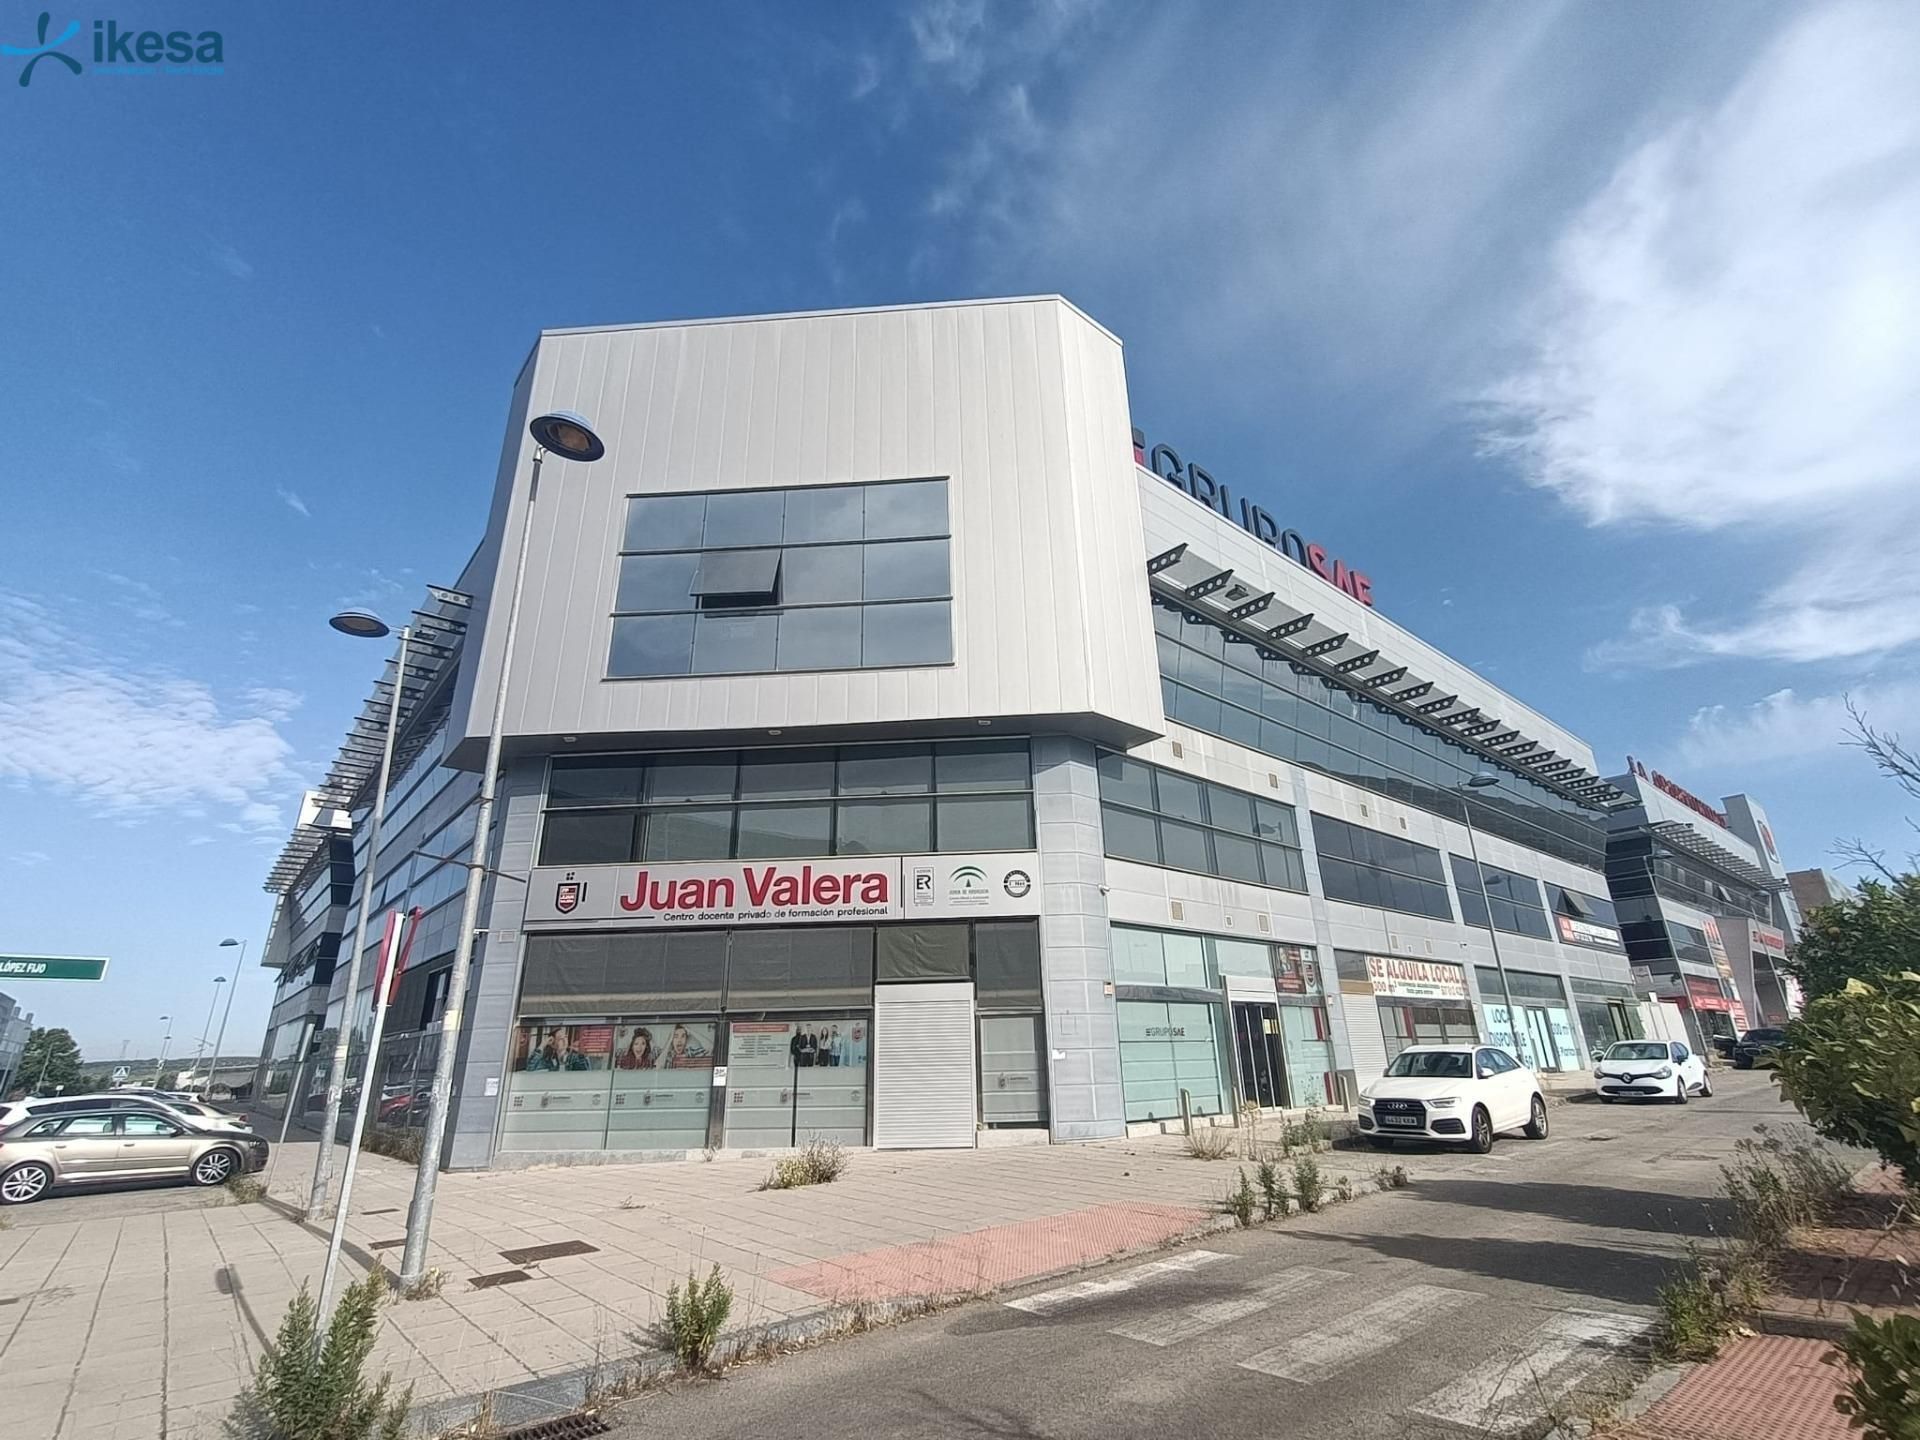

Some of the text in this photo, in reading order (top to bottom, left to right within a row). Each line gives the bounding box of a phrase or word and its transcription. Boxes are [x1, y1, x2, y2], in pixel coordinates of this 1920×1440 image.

[620, 866, 888, 911] Juan Valera
[663, 905, 889, 922] Centro docente privado de formación profesional
[27, 962, 47, 974] FIJO
[1369, 957, 1461, 984] SE ALQUILA LOCAL
